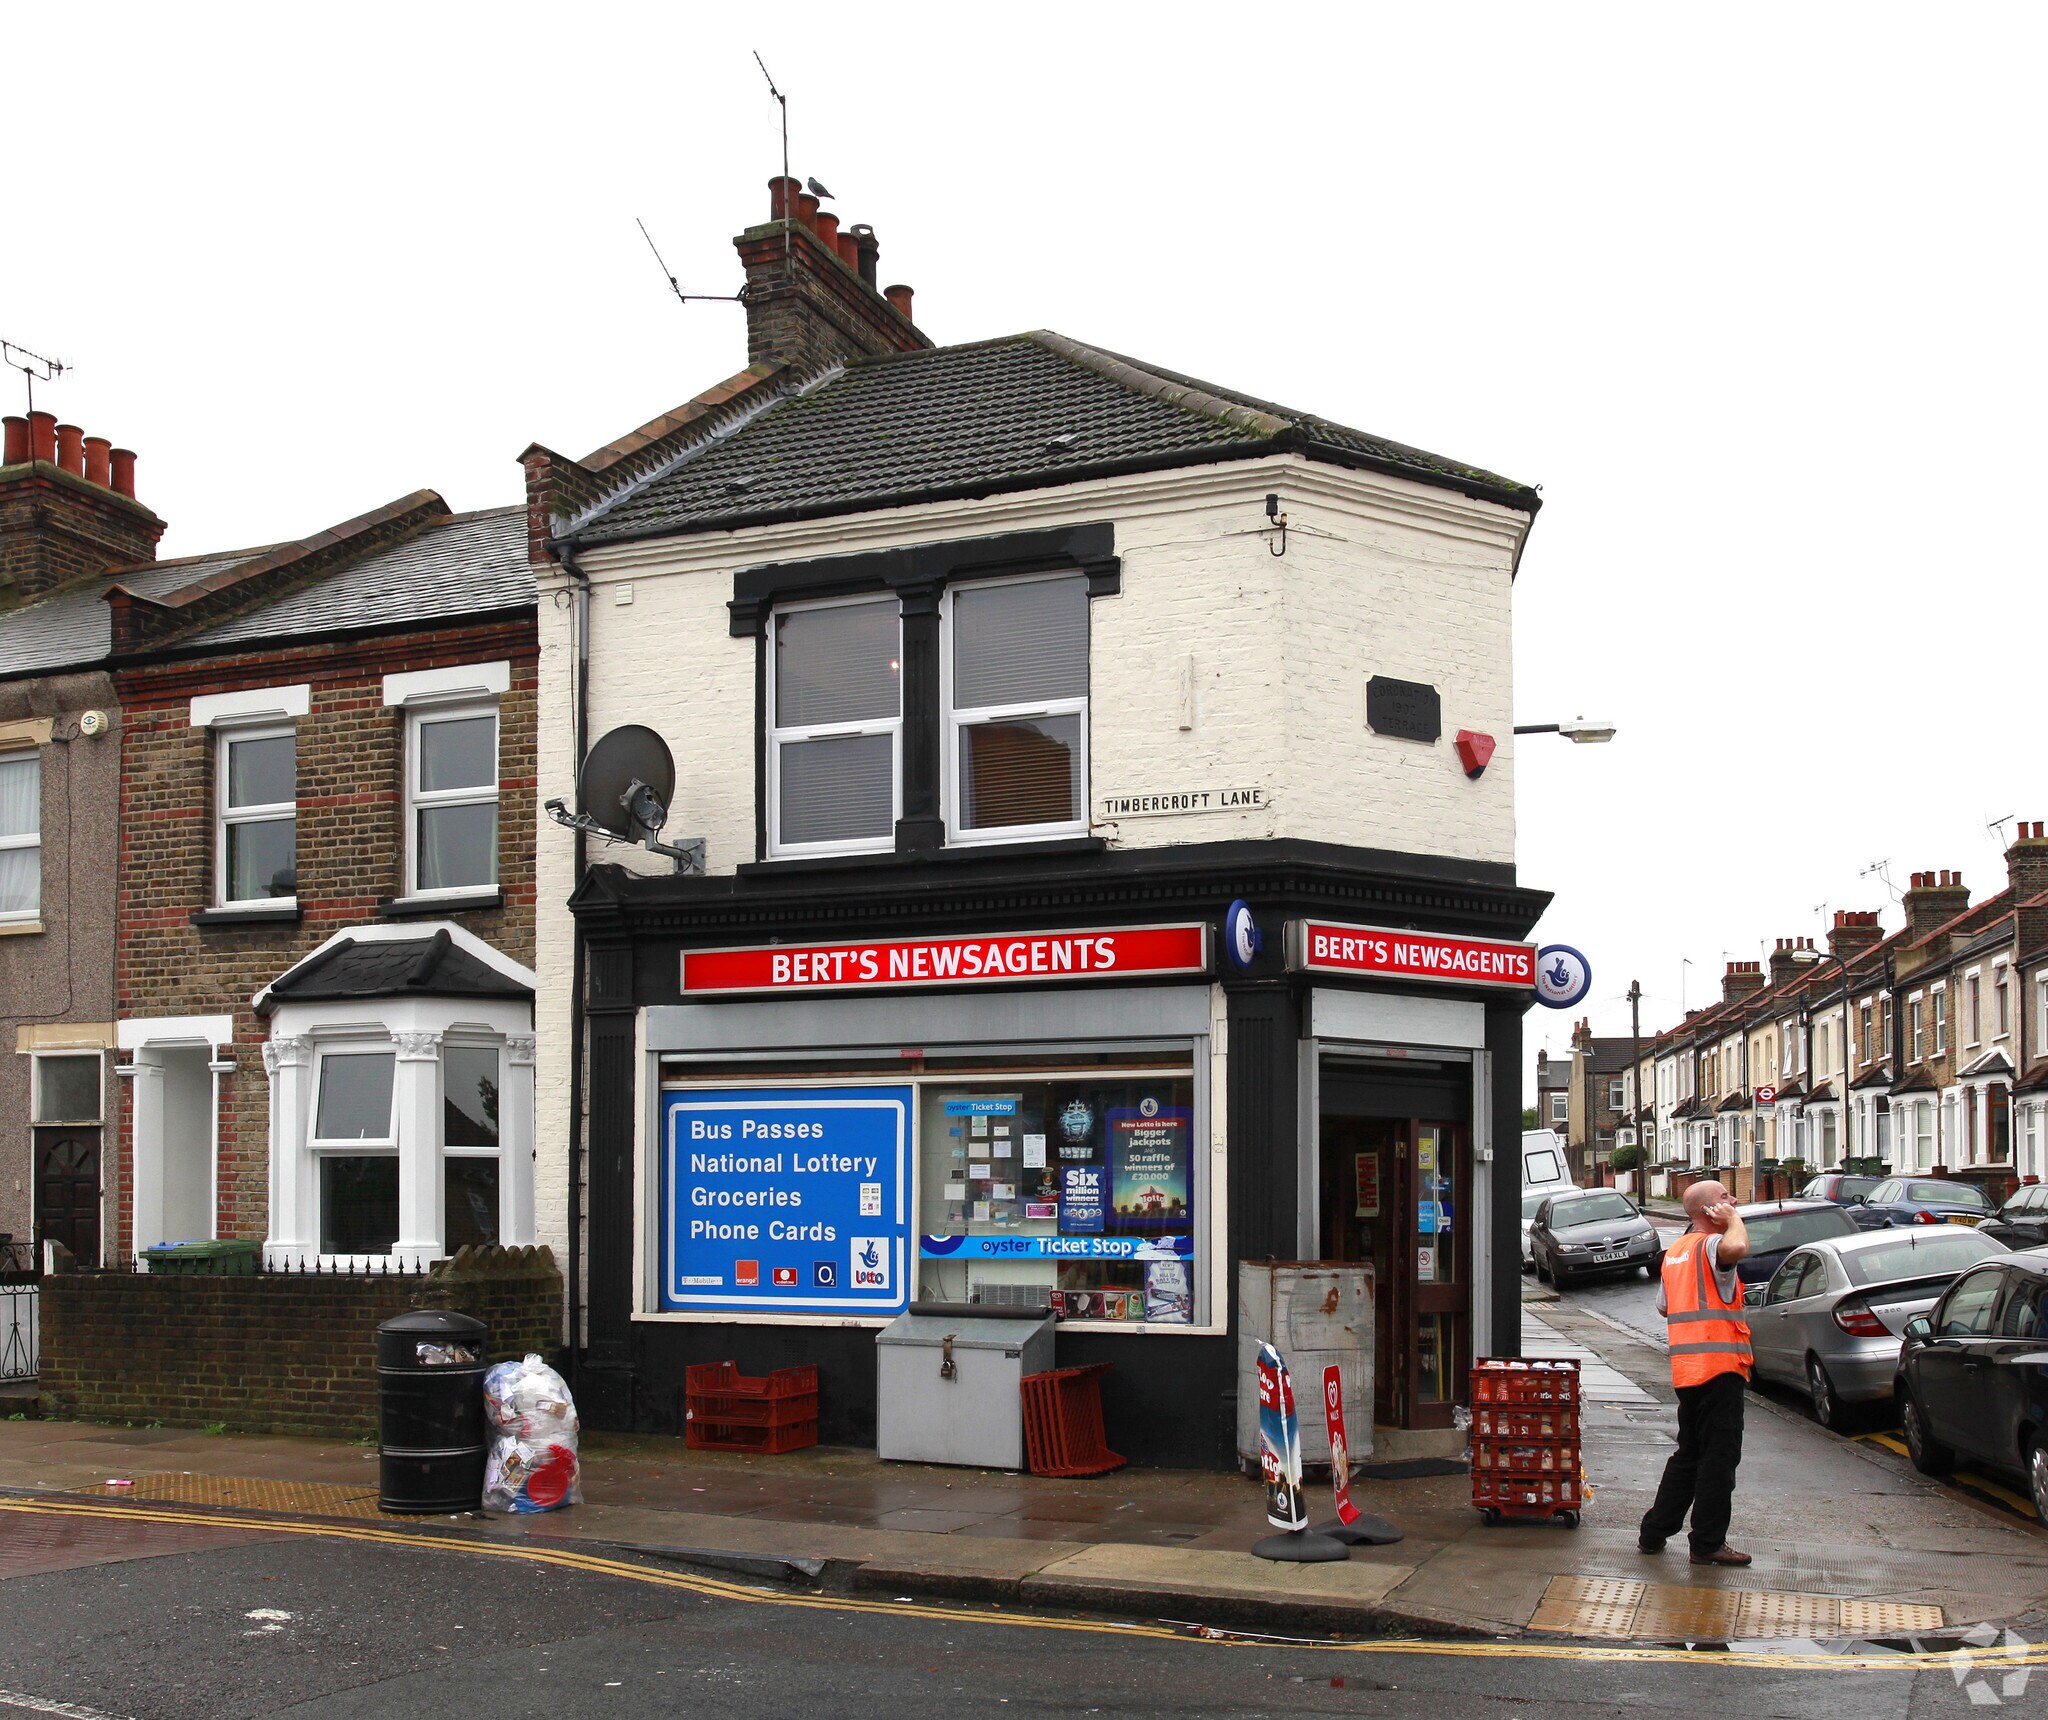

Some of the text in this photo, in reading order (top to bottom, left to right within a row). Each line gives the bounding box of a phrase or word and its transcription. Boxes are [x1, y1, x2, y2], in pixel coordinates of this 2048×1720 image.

[1372, 684, 1436, 707] CORONATION
[1392, 701, 1417, 716] 1902
[1382, 716, 1430, 735] TERRACE
[1105, 789, 1261, 813] TIMBERCROFT LANE
[772, 937, 1117, 984] BERT'S NEWSAGENTS
[1314, 935, 1529, 976] BERT'S NEWSAGENTS
[1545, 984, 1567, 995] National
[1566, 975, 1578, 993] Lottery
[947, 1103, 1013, 1112] oyster Ticket Stop
[690, 1119, 824, 1140] Bus Passes
[1134, 1129, 1166, 1138] Bigger
[1128, 1137, 1171, 1147] jackpots
[690, 1153, 878, 1177] National Lottery
[1142, 1154, 1170, 1162] raffle
[1164, 1163, 1175, 1171] of
[1066, 1168, 1099, 1186] Six
[690, 1186, 802, 1207] Groceries
[1065, 1186, 1099, 1195] million
[1065, 1194, 1099, 1202] winners
[1142, 1194, 1165, 1203] lotto
[690, 1220, 837, 1242] Phone Cards
[981, 1238, 1132, 1256] oyster Ticket Stop
[818, 1265, 835, 1285] O2
